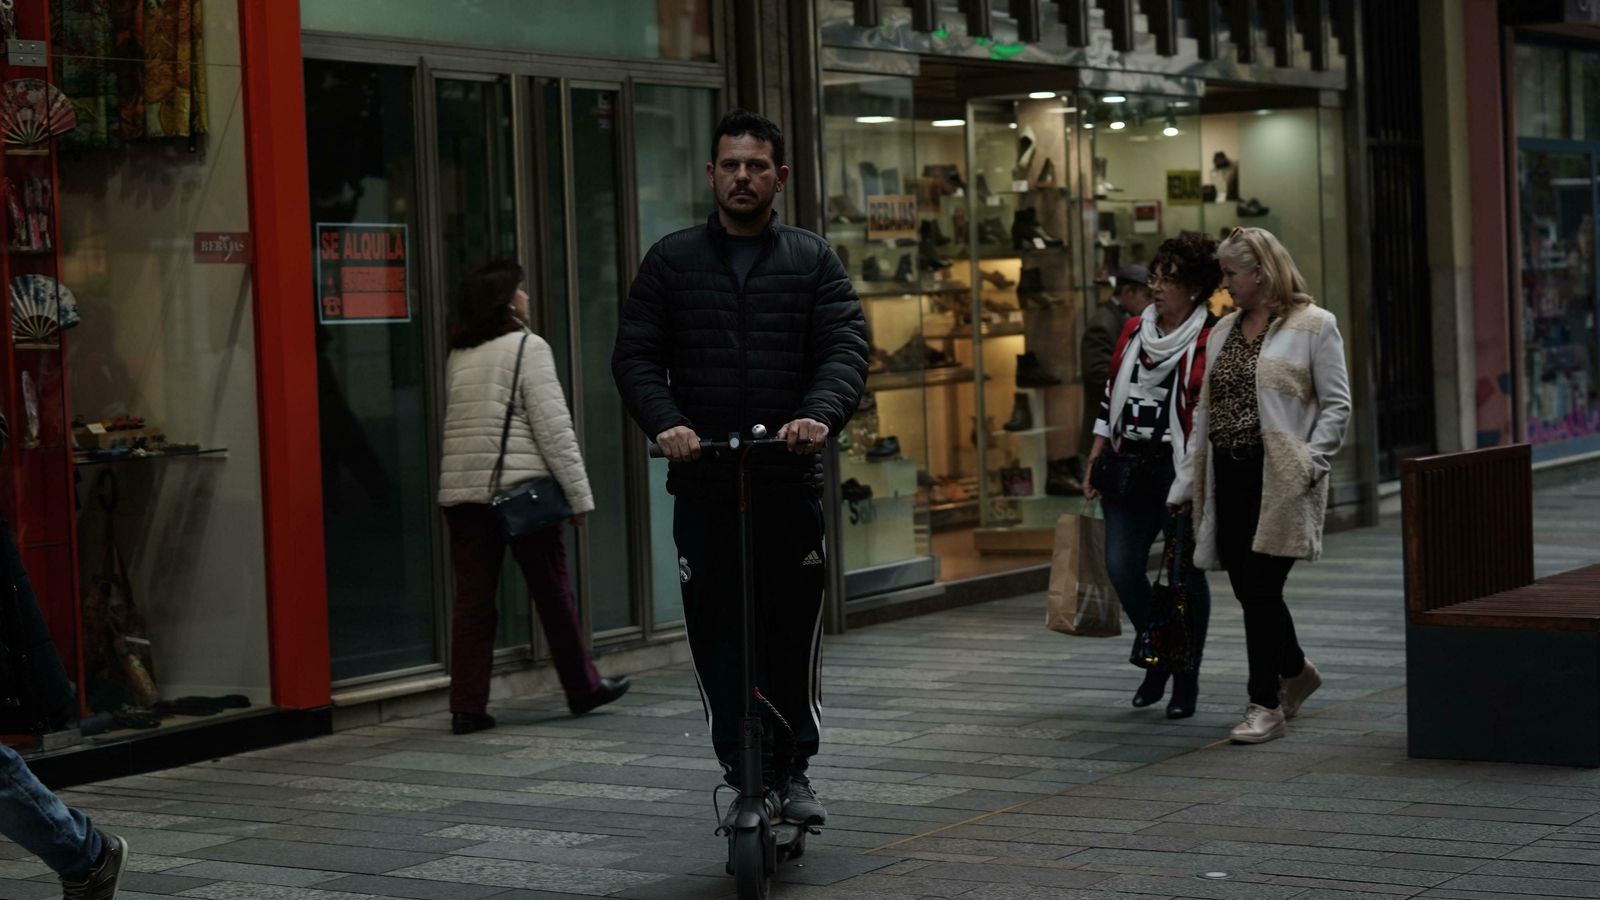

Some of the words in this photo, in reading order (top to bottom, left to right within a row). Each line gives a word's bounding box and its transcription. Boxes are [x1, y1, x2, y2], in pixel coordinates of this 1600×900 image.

[201, 237, 246, 261] REBAJAS
[320, 231, 340, 260] SE
[343, 232, 405, 261] ALQUILA
